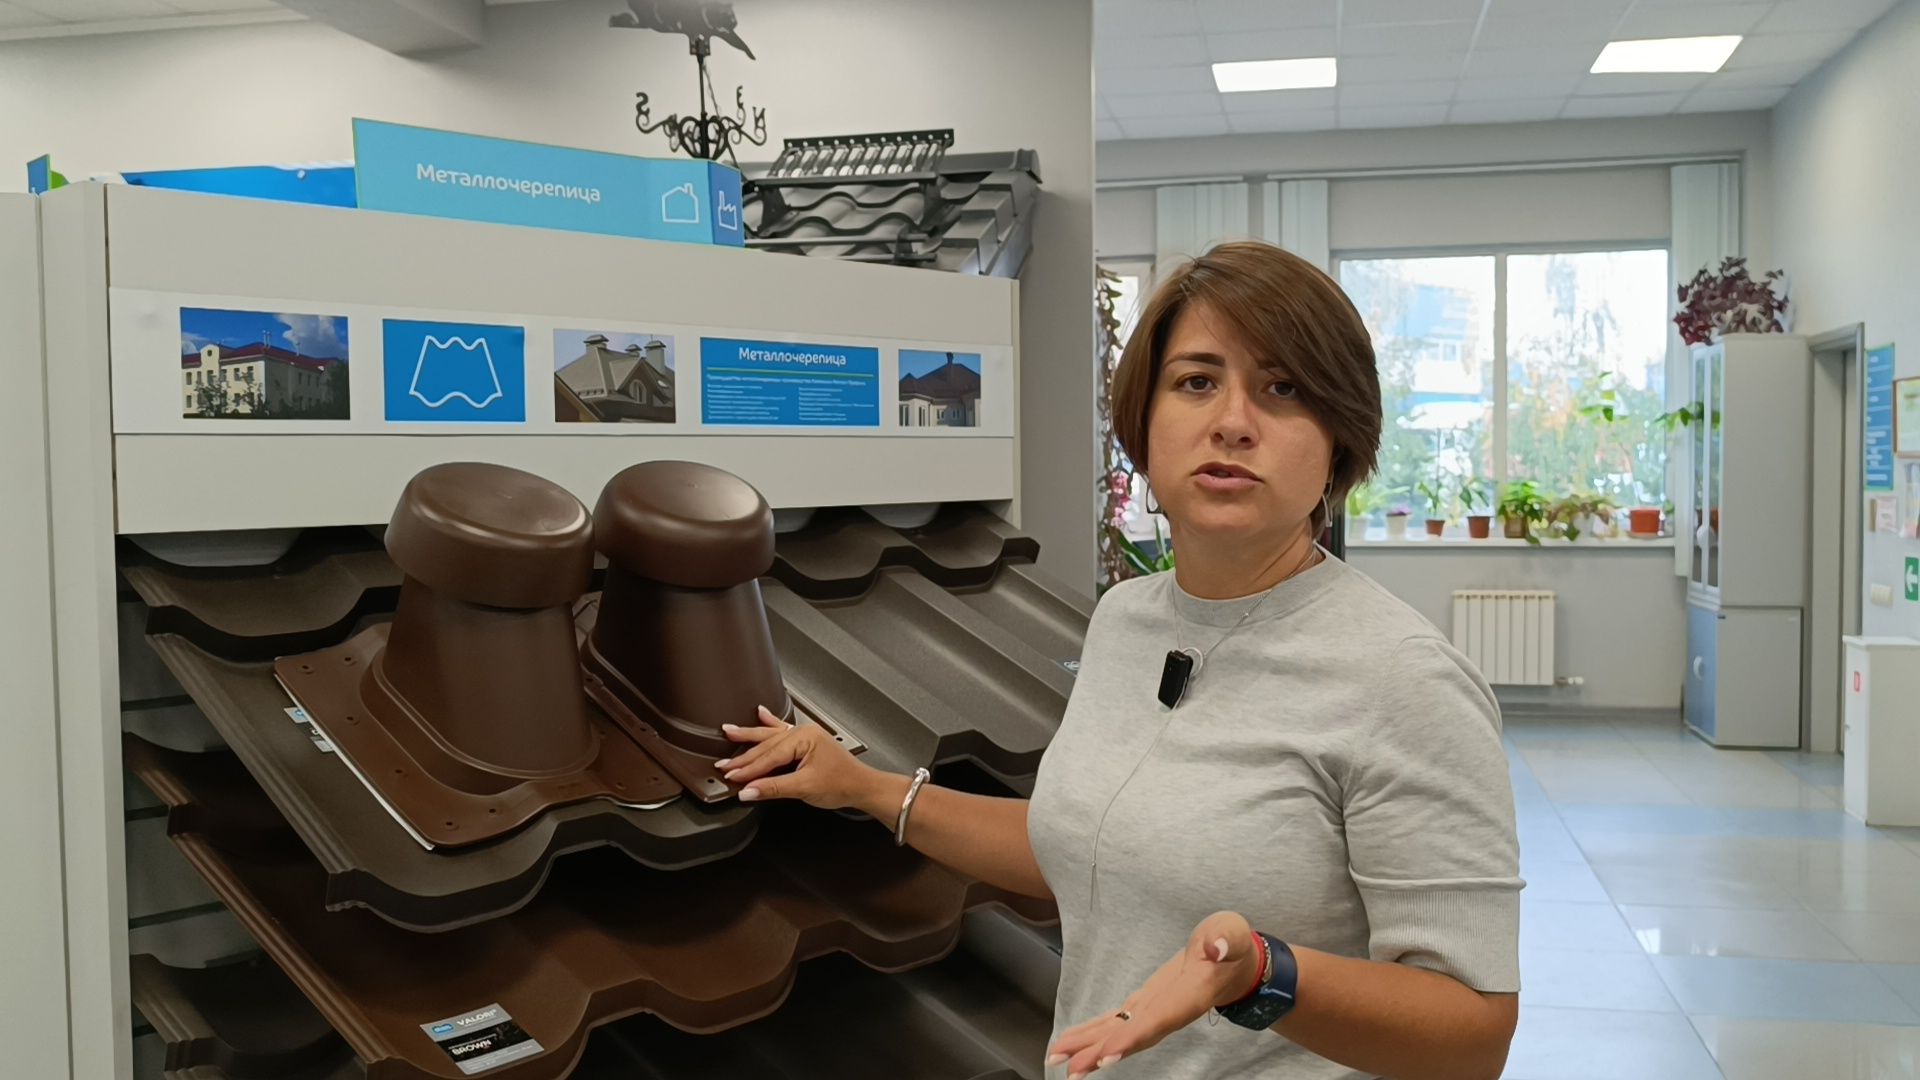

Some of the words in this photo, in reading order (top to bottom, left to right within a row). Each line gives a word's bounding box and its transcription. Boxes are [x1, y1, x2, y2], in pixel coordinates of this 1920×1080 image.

[416, 162, 601, 204] Металлочерепица
[738, 346, 847, 367] Металлочерепица
[451, 1039, 492, 1056] BROWN
